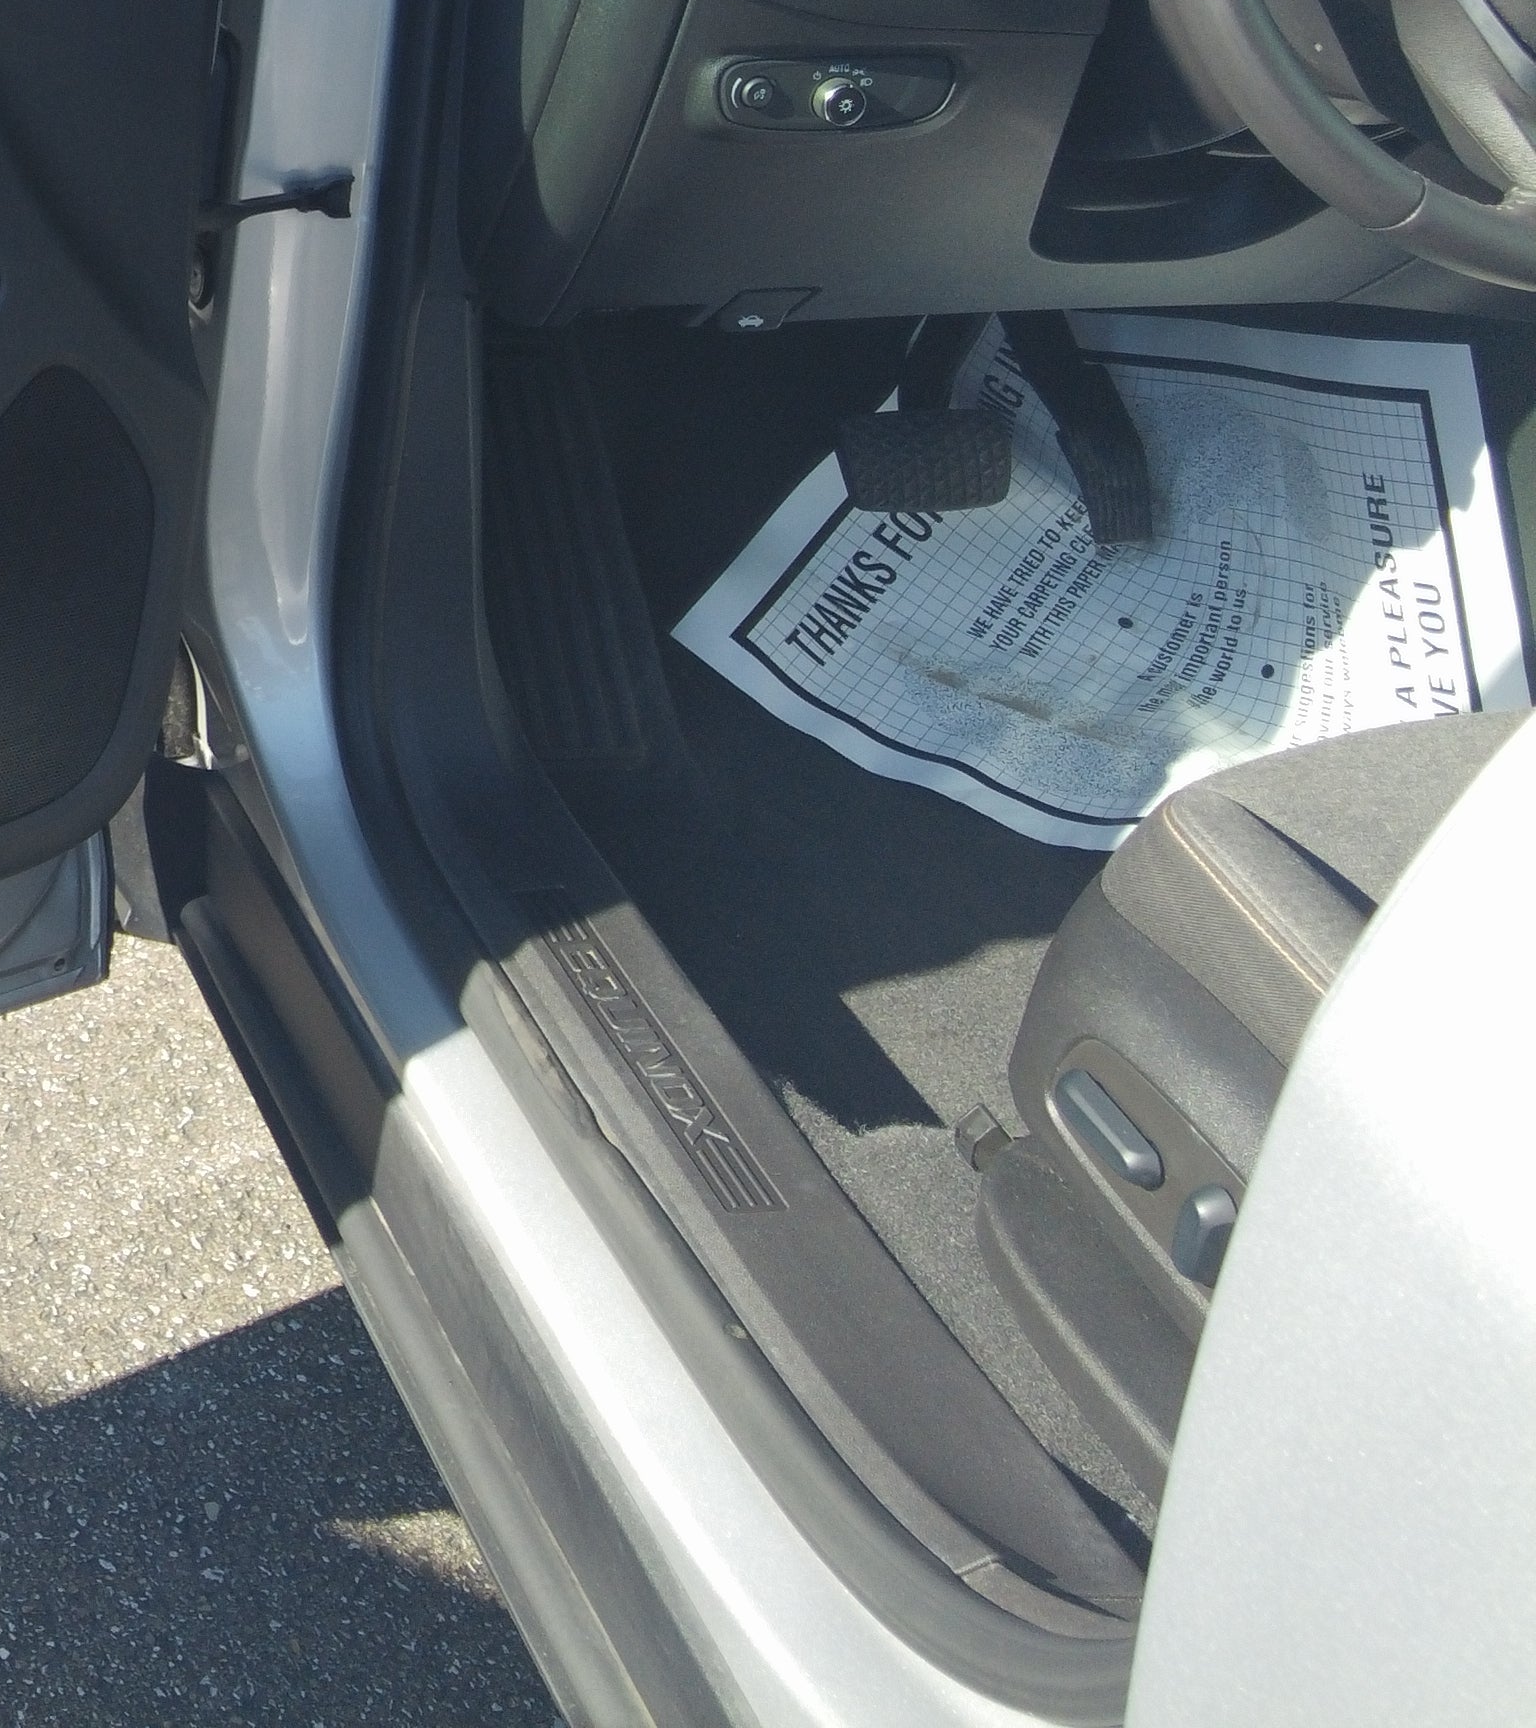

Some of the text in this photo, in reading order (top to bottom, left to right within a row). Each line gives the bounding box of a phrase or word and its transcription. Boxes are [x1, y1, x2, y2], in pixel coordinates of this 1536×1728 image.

[828, 63, 850, 73] AUTO
[785, 550, 897, 667] THANKS
[872, 511, 943, 562] FO
[966, 616, 994, 639] WE
[983, 584, 1019, 620] HAVE
[1008, 548, 1045, 587] TRIED
[1037, 528, 1061, 550] TO
[989, 617, 1027, 652] YOUR
[1017, 551, 1078, 619] CARPETING
[1018, 625, 1056, 659] WITH
[1043, 597, 1077, 627] THIS
[1066, 559, 1107, 599] PAPER
[1138, 696, 1164, 714] the
[1175, 604, 1223, 683] important
[1214, 540, 1231, 602] person
[1146, 611, 1197, 675] customer
[1186, 592, 1204, 608] is
[1319, 581, 1333, 650] service
[1363, 472, 1418, 709] A PLEASURE
[1413, 581, 1449, 658] YOU
[1209, 635, 1239, 683] world
[1227, 614, 1243, 632] to
[1295, 583, 1316, 727] suggestions for
[559, 946, 730, 1146] EQUINOX
